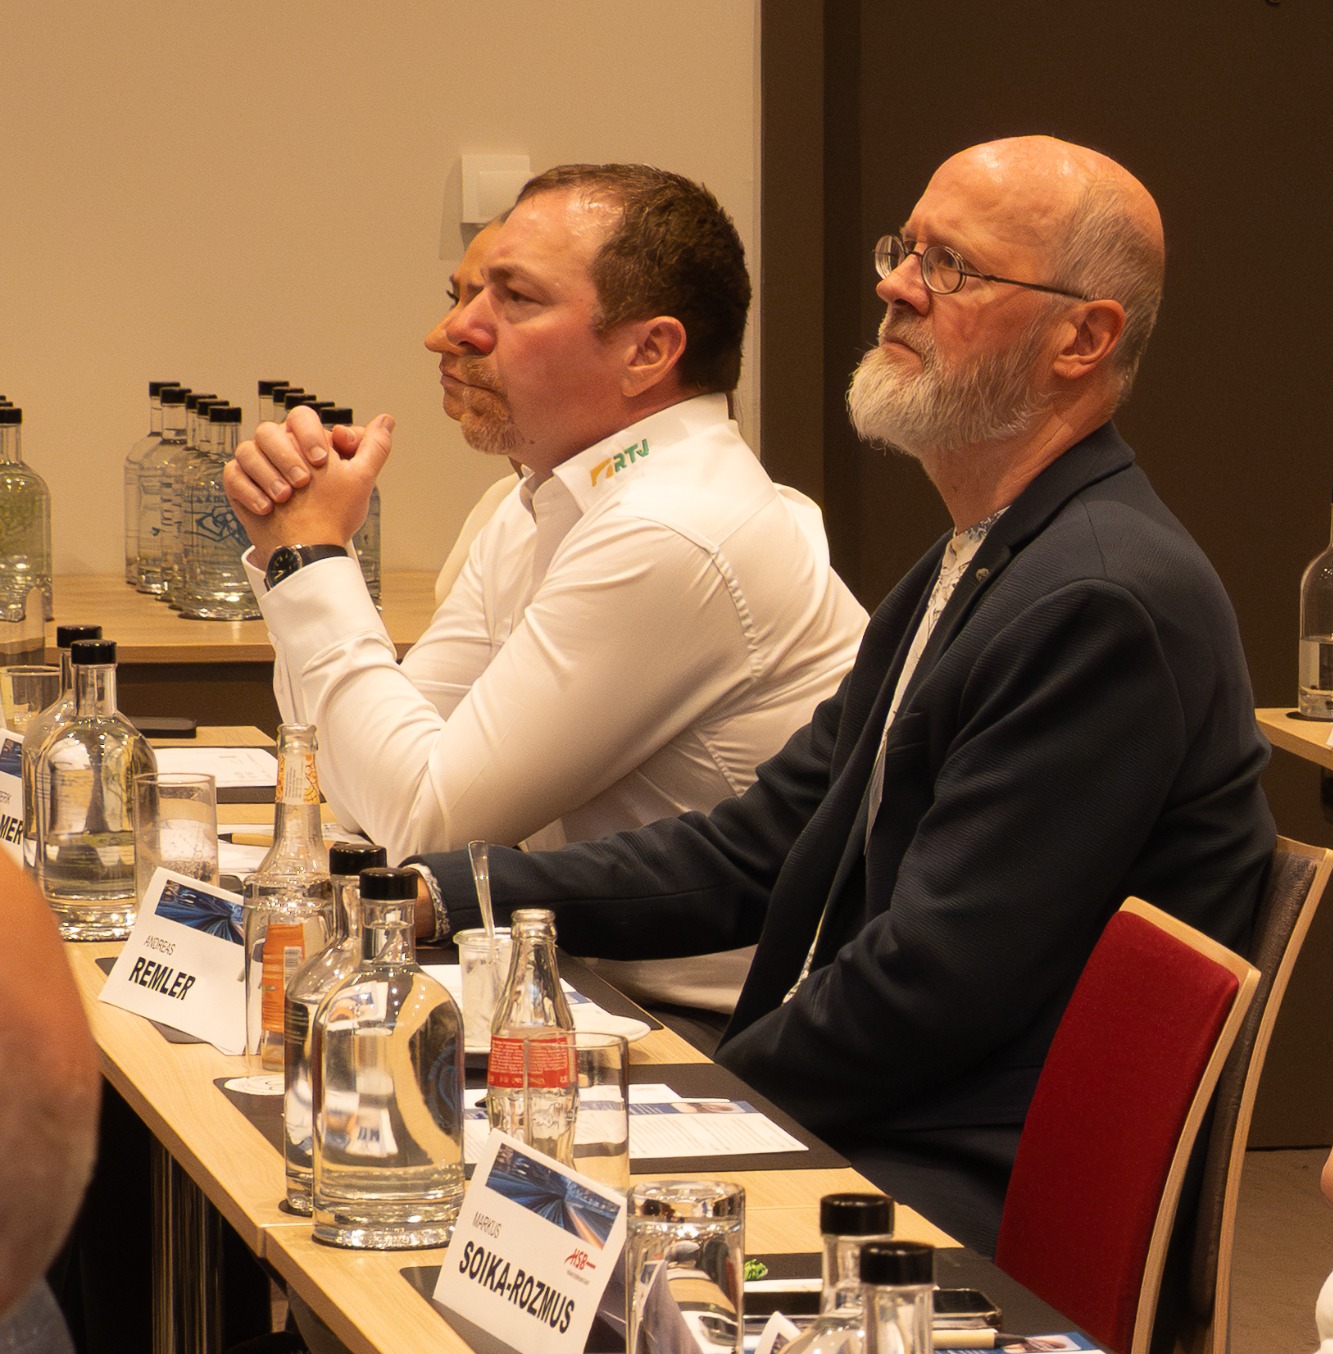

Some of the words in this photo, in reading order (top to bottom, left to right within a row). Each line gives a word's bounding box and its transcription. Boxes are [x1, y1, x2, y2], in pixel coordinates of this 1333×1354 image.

[144, 935, 176, 956] ANDREAS
[128, 957, 196, 1000] REMLER
[473, 1212, 502, 1239] MARKUS
[459, 1241, 575, 1334] SOIKA-ROZMUS
